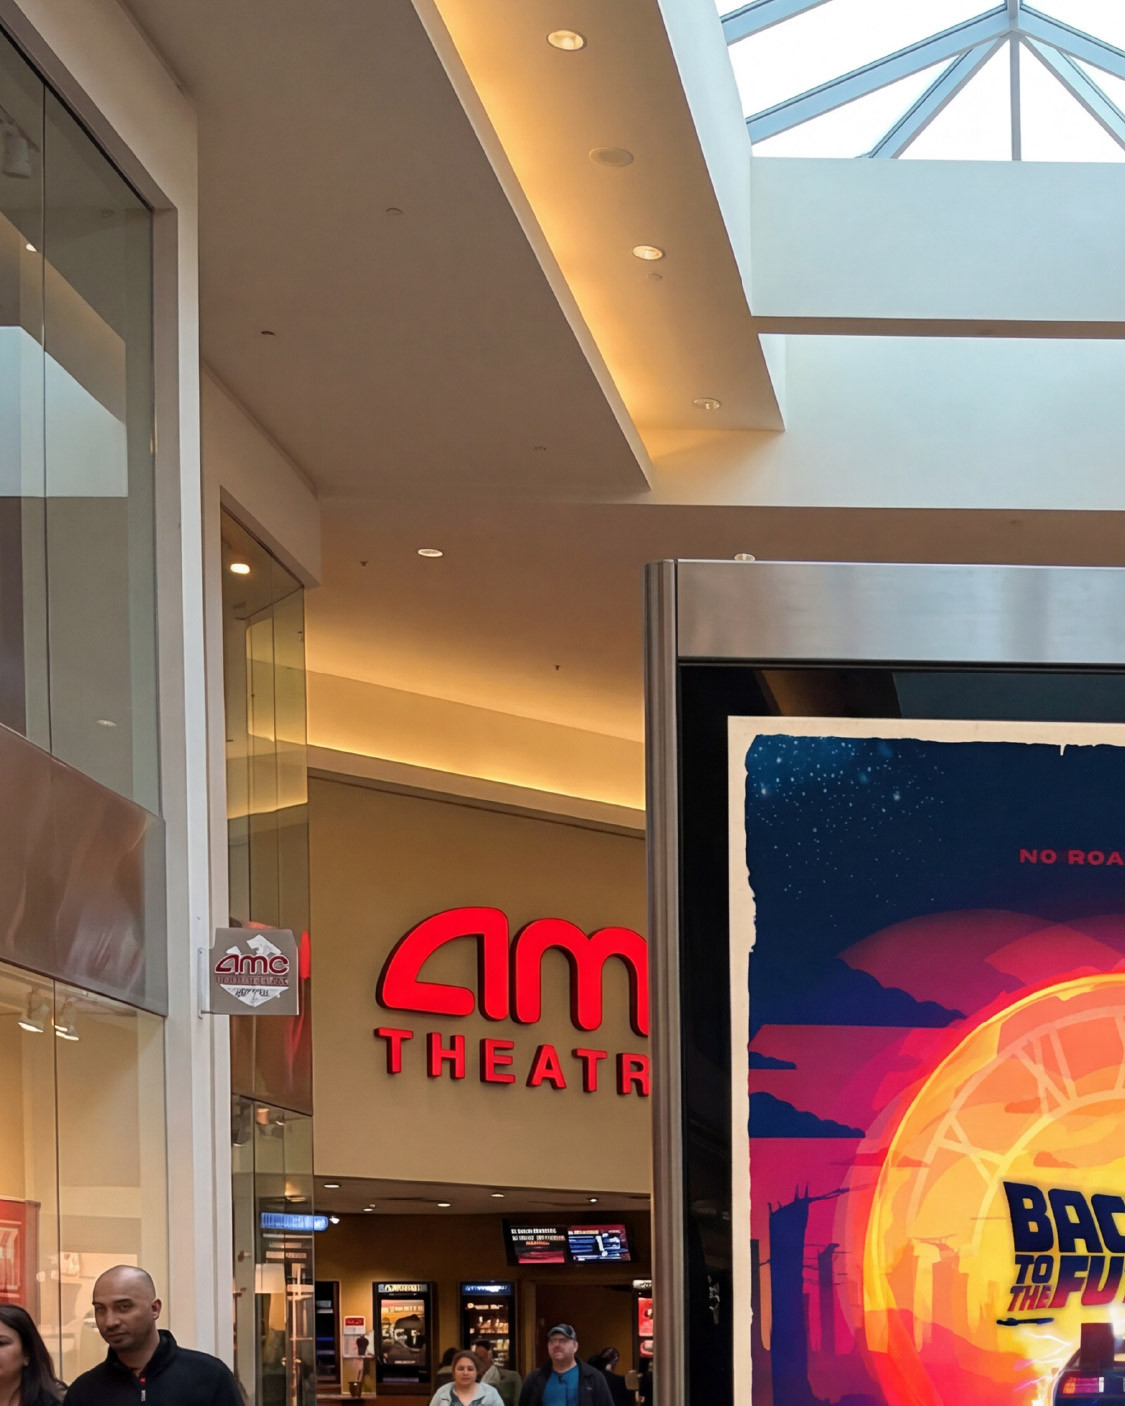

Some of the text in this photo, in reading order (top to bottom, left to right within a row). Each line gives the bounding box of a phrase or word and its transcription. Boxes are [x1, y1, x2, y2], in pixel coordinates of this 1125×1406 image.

[1019, 849, 1058, 865] NO
[374, 1027, 650, 1097] THEATR
[1015, 1254, 1054, 1284] TO
[1007, 1285, 1052, 1311] THE
